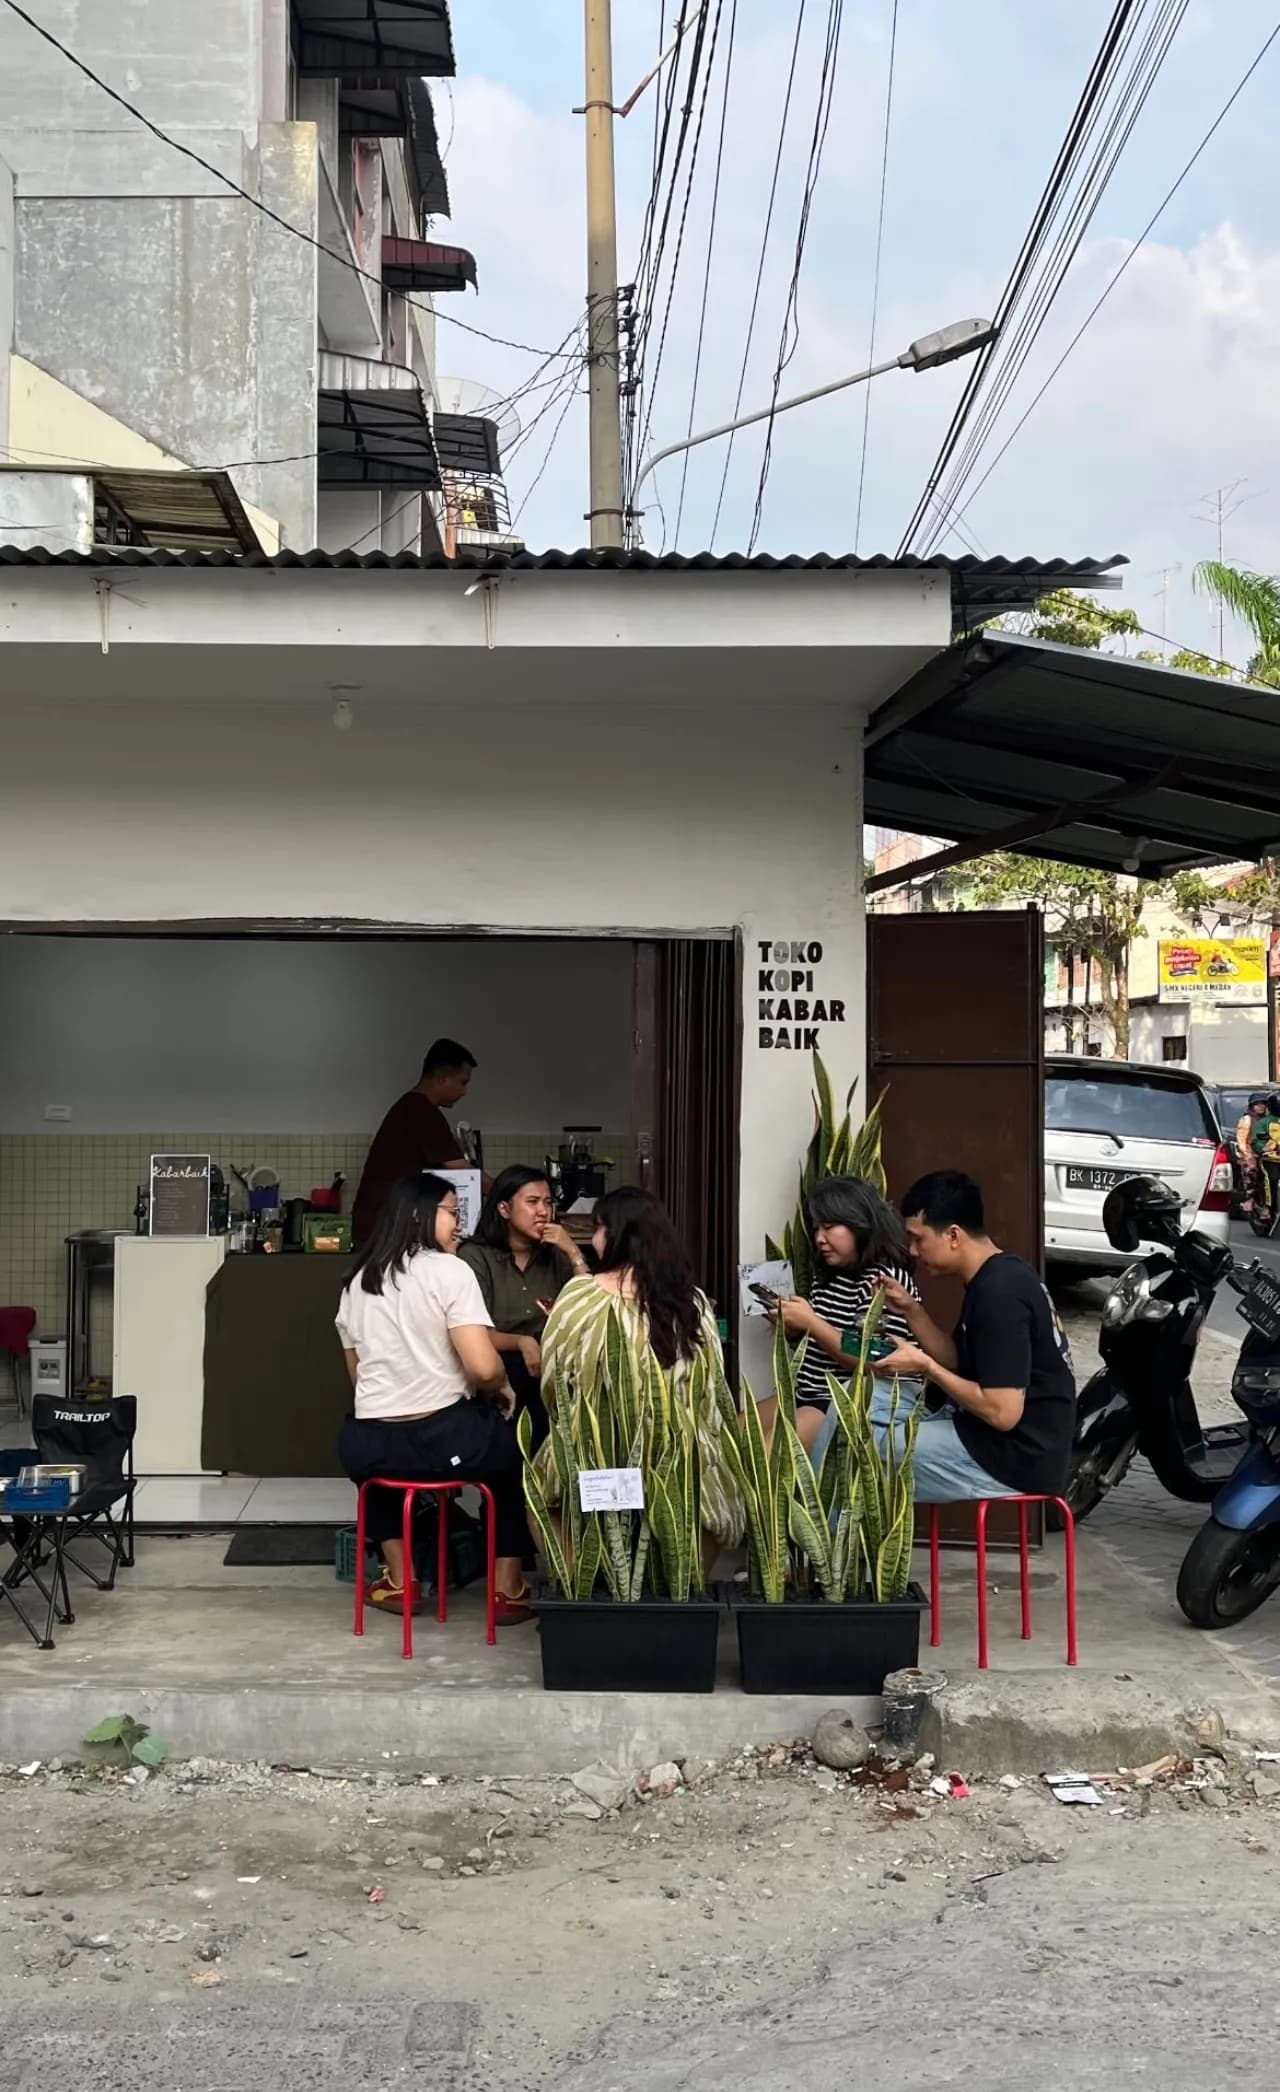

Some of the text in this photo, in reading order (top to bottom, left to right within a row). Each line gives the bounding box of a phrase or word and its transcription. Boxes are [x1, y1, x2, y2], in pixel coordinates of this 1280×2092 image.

[758, 941, 823, 964] TOKO
[758, 969, 813, 992] KOPI
[758, 998, 845, 1022] KABAR
[758, 1027, 820, 1050] BAIK
[1069, 1168, 1083, 1182] BK
[1090, 1170, 1115, 1185] 1372
[53, 1409, 111, 1423] TRAILTOP
